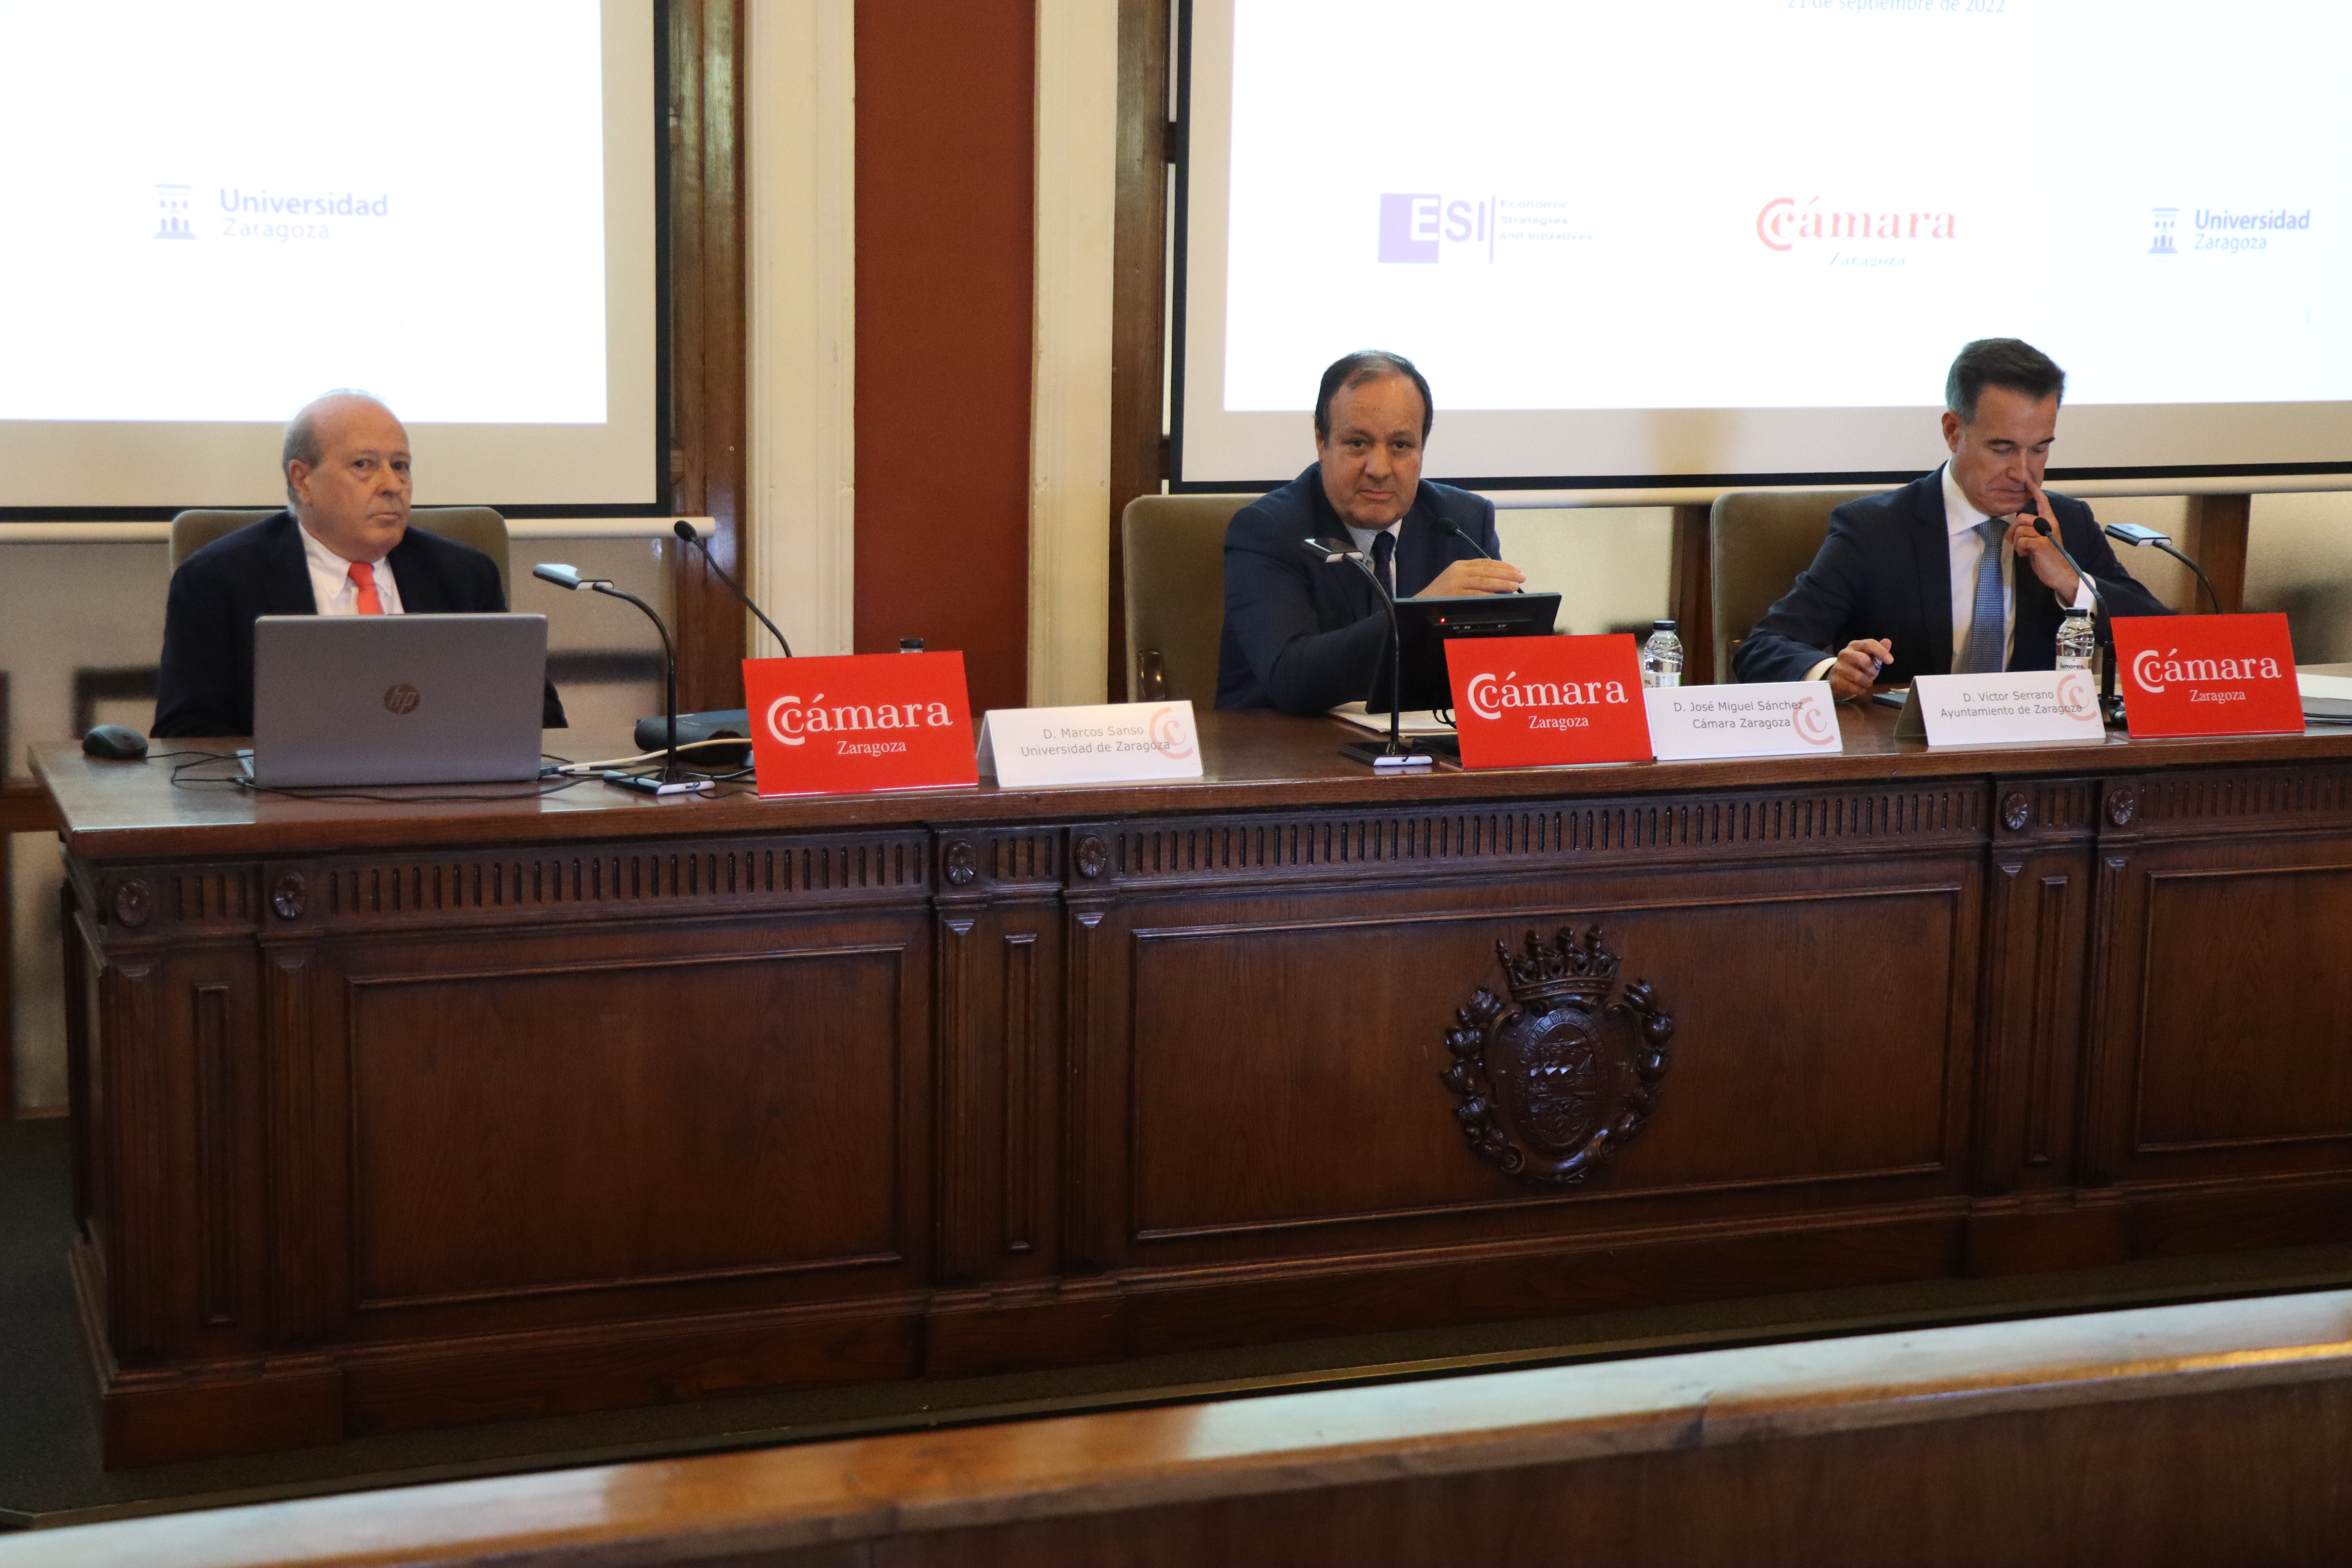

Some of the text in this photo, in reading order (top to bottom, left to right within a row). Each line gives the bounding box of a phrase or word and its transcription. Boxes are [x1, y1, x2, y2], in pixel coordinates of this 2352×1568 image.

[1965, 0, 2005, 13] 2022
[220, 187, 388, 217] Universidad
[1500, 199, 1568, 209] Economic
[1411, 198, 1486, 243] ESI
[1499, 215, 1568, 226] Strategies
[2196, 209, 2310, 230] Universidad
[222, 217, 330, 243] Zaragoza
[1499, 231, 1593, 241] and Initiatives
[2194, 234, 2267, 254] Zaragoza
[1829, 252, 1905, 270] Zaragoza
[1963, 690, 2054, 702] D. Víctor Serrano
[2190, 690, 2246, 704] Zaragoza
[1674, 700, 1804, 713] D. José Miguel Sánchez
[1941, 704, 2082, 719] Ayuntamiento de Zaragoza
[1529, 715, 1590, 731] Zaragoza
[1693, 719, 1791, 729] Cámara Zaragoza
[1043, 726, 1143, 739] D. Marcos Sanso
[837, 741, 907, 757] Zaragoza
[1021, 740, 1170, 756] Universidad de Zaragoza
